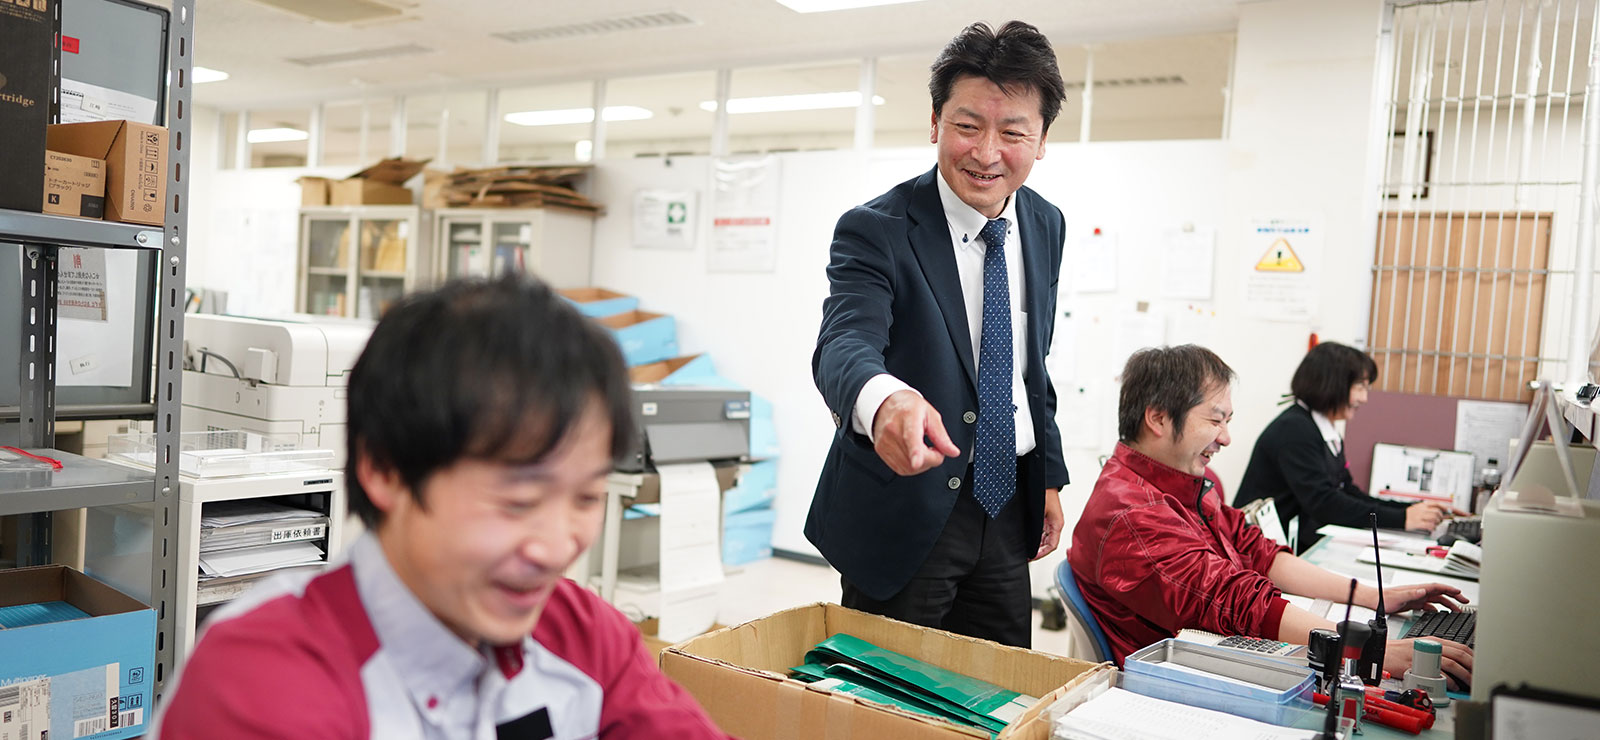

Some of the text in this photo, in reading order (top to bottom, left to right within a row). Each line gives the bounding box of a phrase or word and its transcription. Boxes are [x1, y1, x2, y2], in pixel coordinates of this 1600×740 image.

[49, 178, 91, 188] トナーカートリッジ
[51, 195, 57, 203] K
[273, 527, 321, 540] 出庫依頼書
